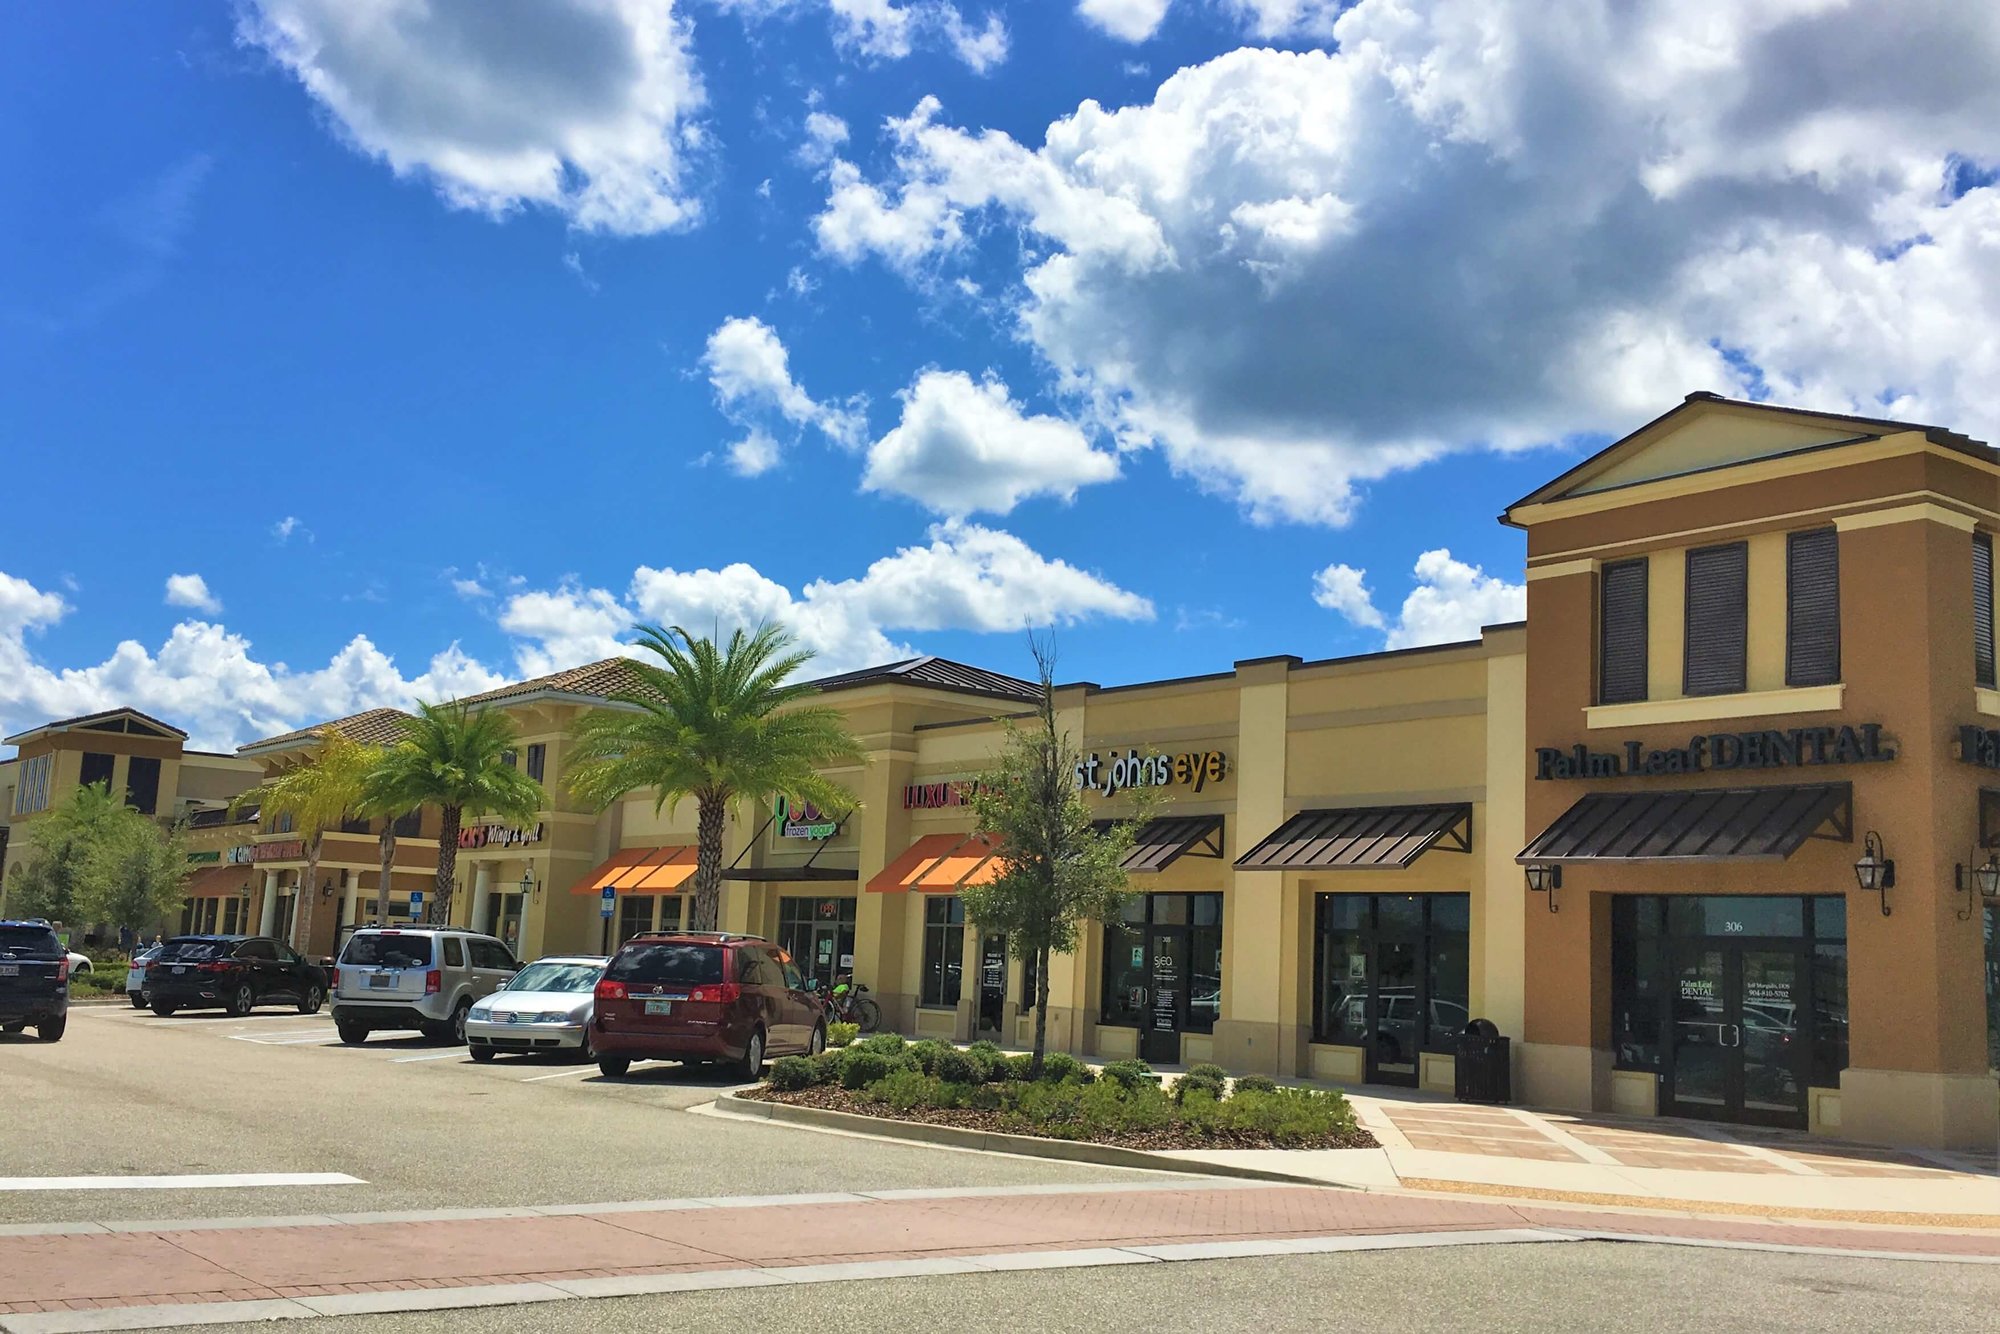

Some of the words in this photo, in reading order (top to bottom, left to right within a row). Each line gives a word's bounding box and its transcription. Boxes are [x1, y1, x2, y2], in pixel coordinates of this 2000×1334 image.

[1535, 744, 1620, 780] Palm
[1624, 735, 1706, 774] Leaf
[1708, 724, 1895, 770] DENTAL
[1102, 750, 1169, 797] johns
[1174, 751, 1223, 792] eye
[786, 823, 808, 837] frozen
[808, 822, 837, 840] yogurt
[1724, 921, 1743, 932] 306
[1681, 987, 1714, 996] DENTAL
